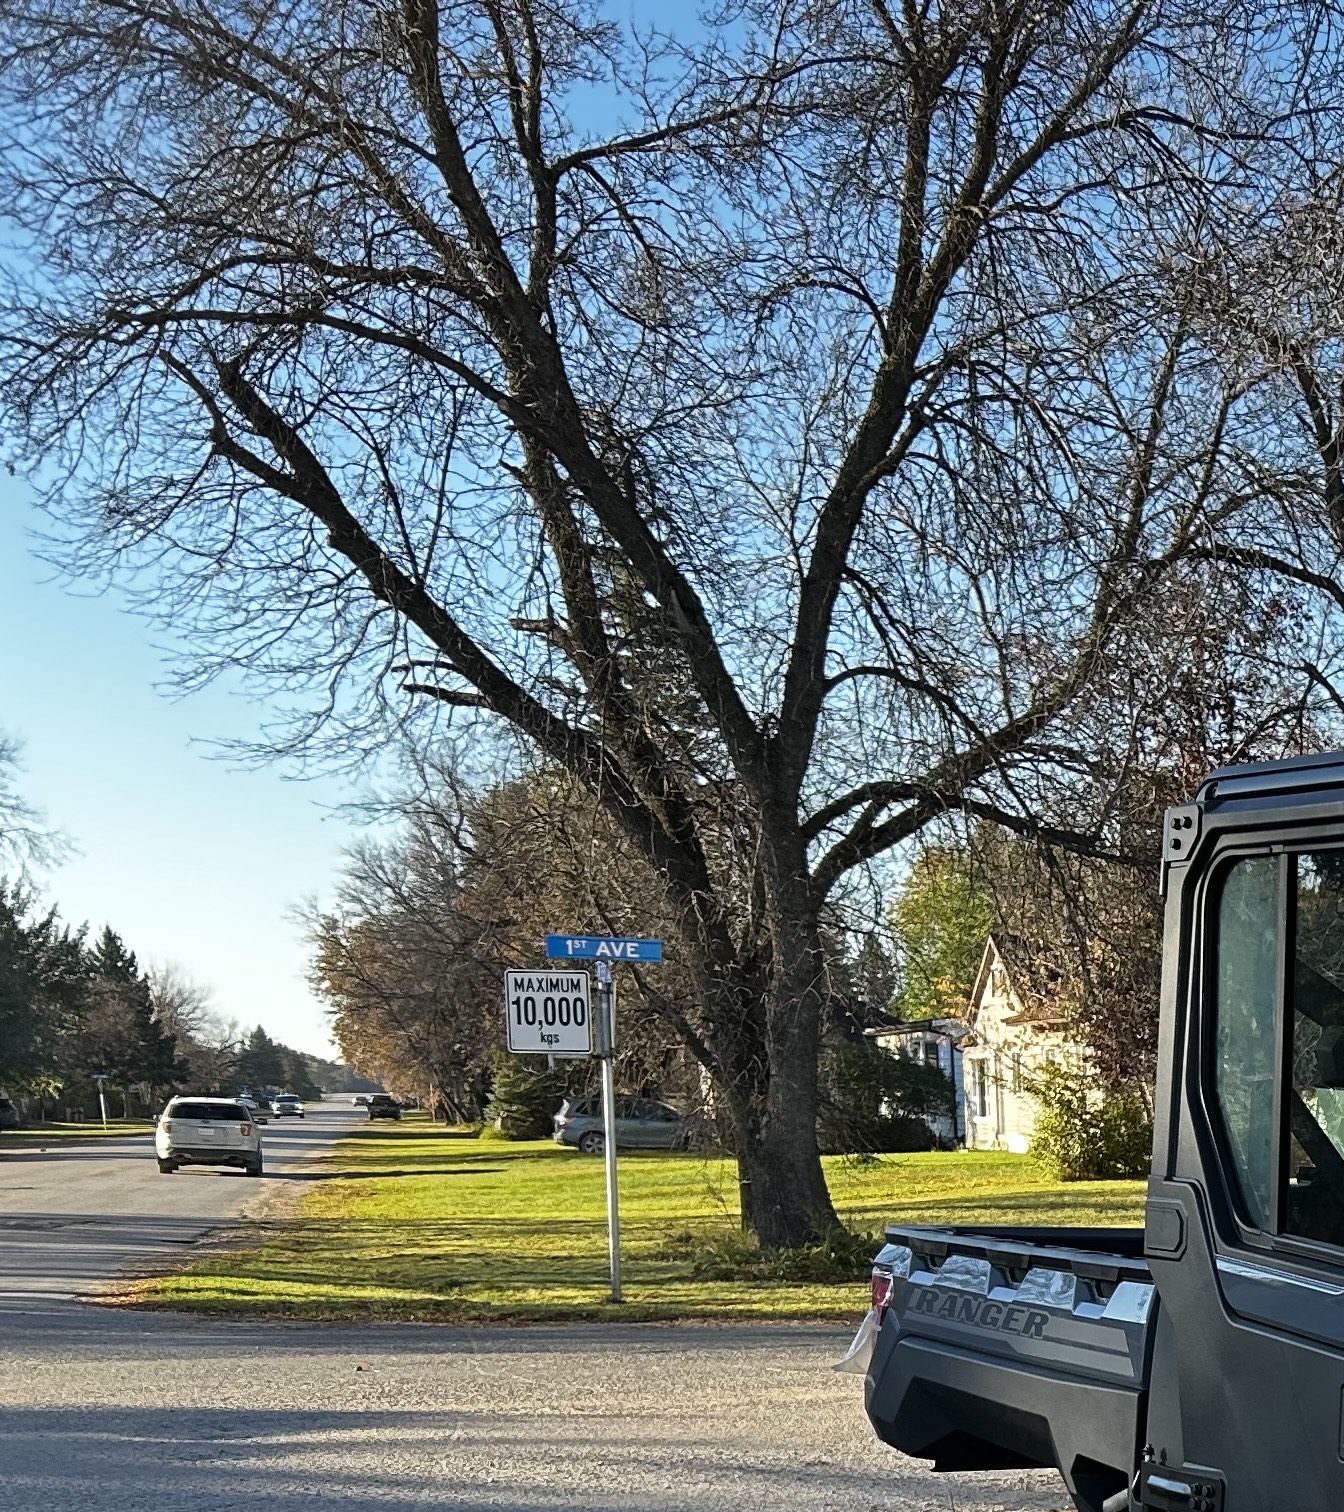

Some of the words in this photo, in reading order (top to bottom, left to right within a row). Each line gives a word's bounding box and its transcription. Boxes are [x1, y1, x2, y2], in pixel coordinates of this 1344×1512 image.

[566, 940, 587, 955] 1ST
[595, 941, 640, 958] AVE
[513, 976, 581, 993] MAXIMUM
[511, 996, 586, 1031] 10,000
[540, 1031, 560, 1045] kgs
[913, 1287, 1050, 1339] RANGER
